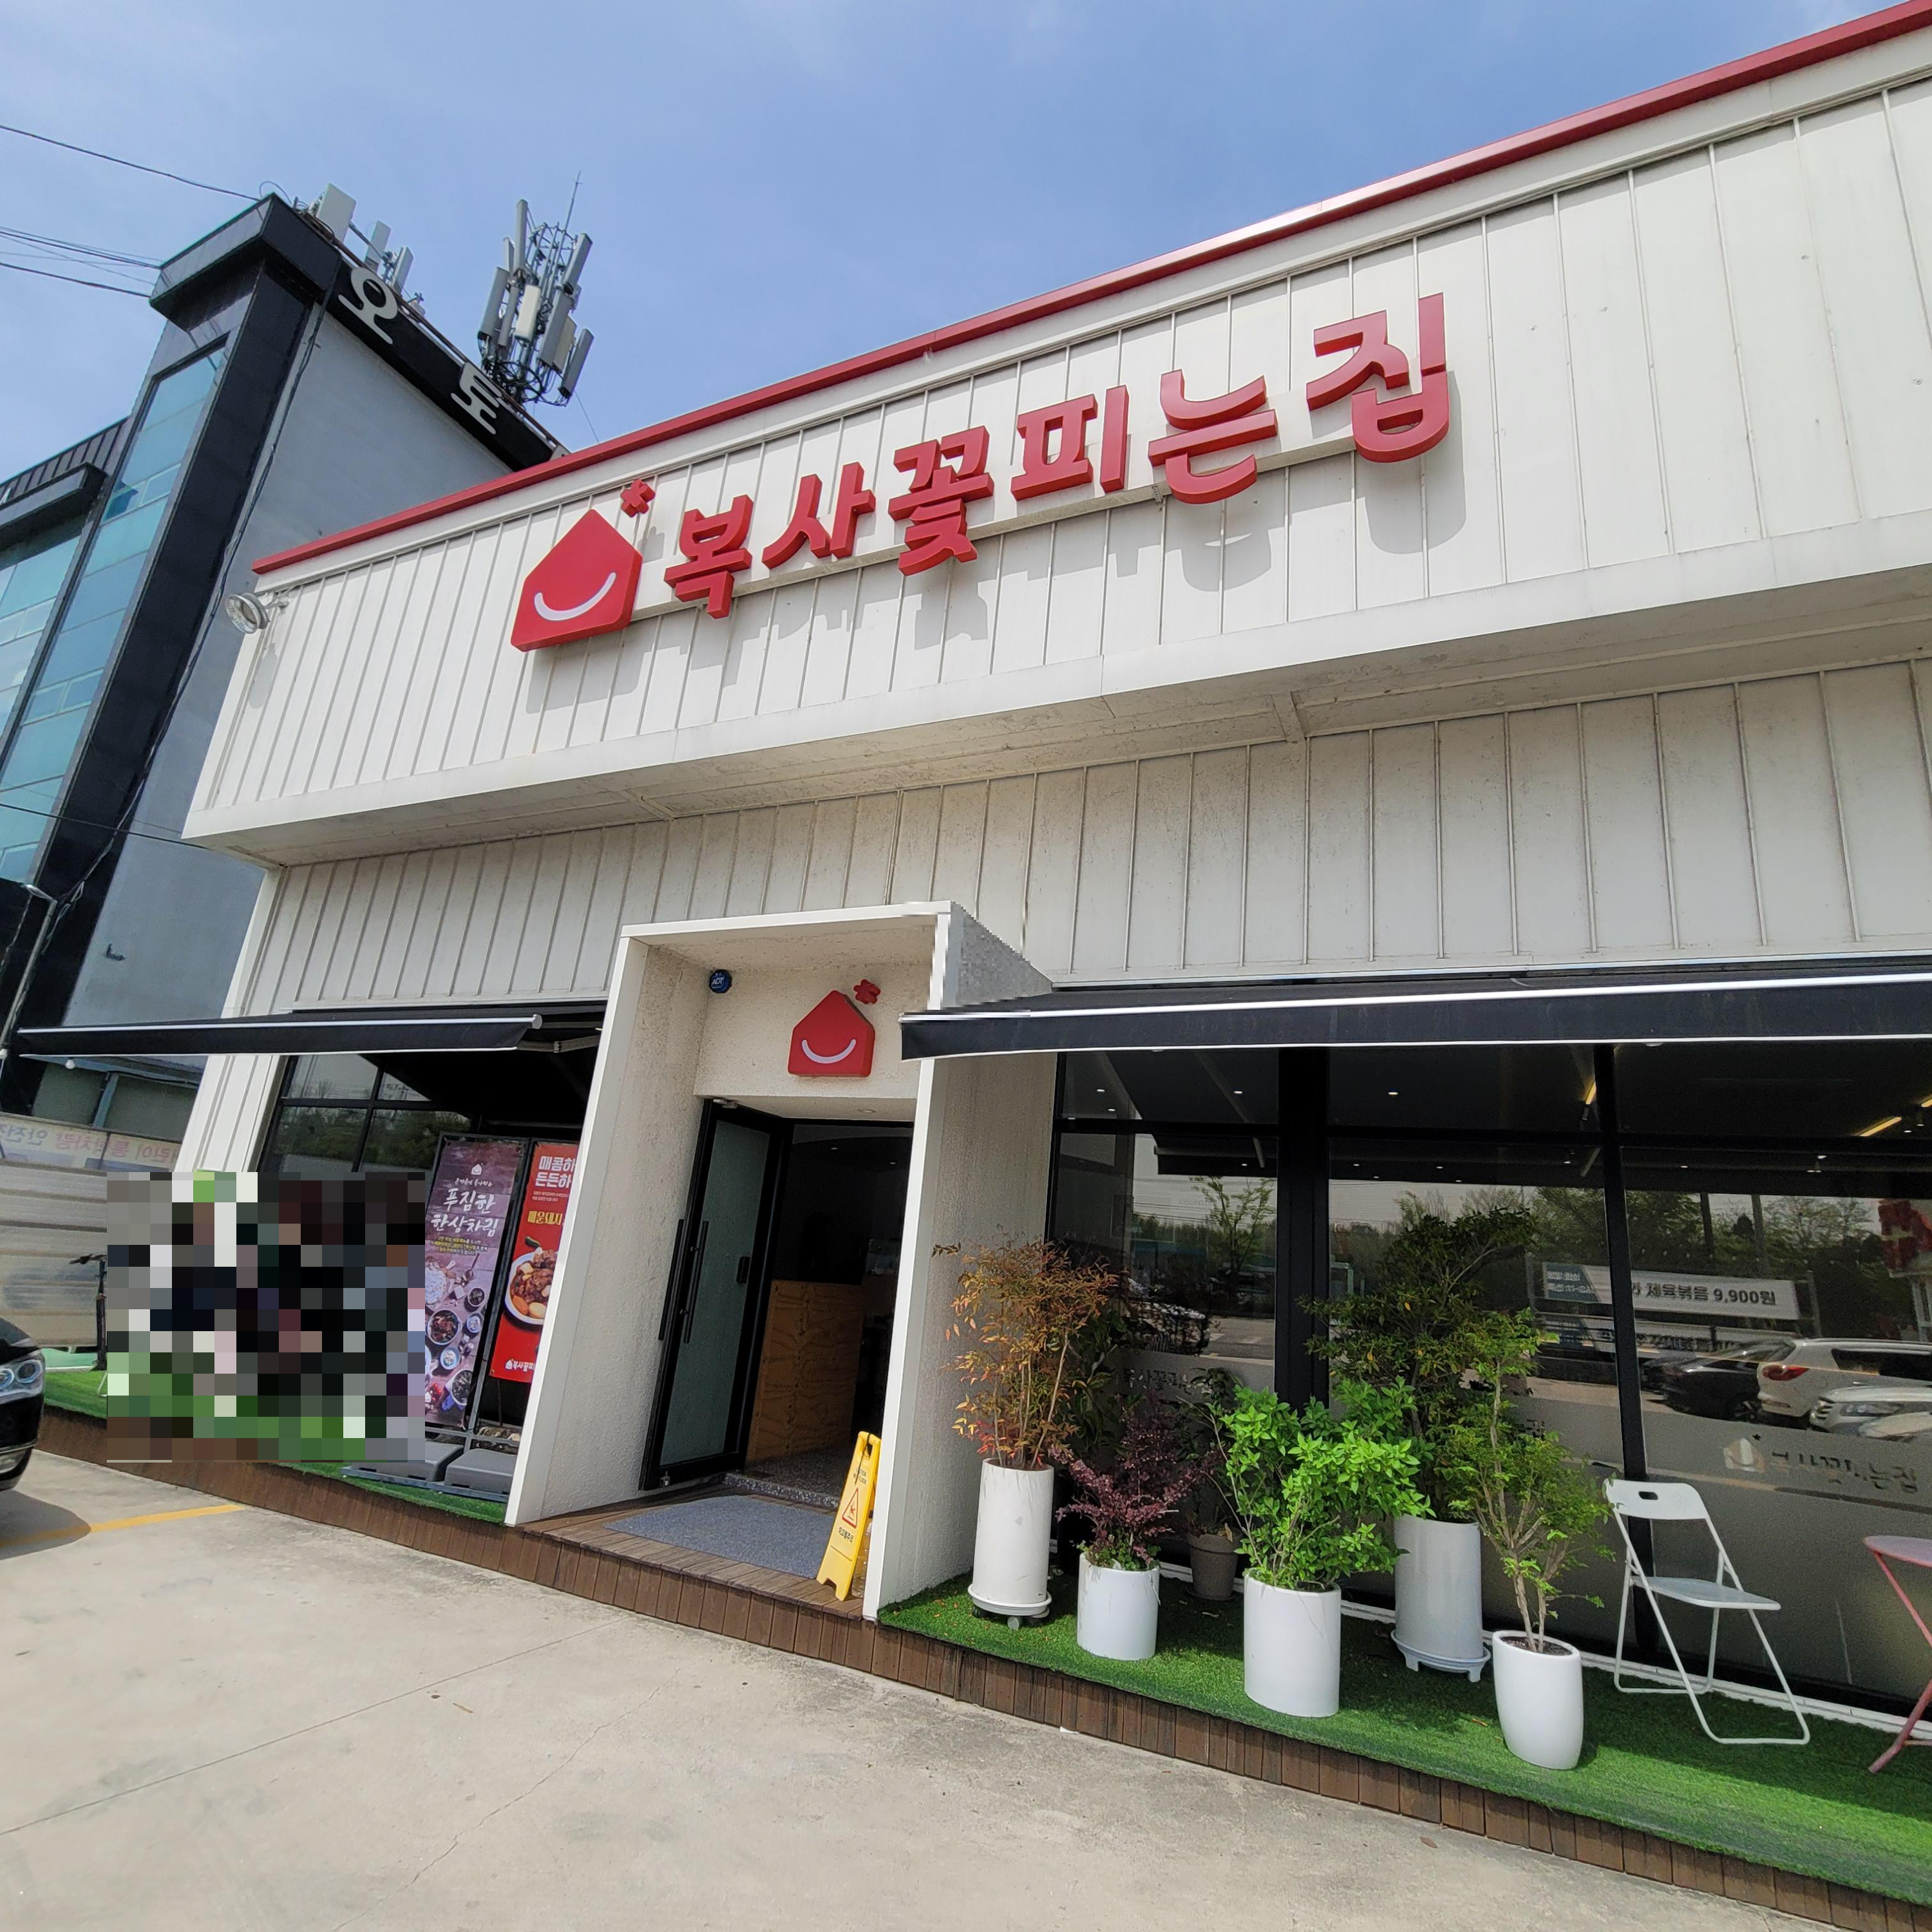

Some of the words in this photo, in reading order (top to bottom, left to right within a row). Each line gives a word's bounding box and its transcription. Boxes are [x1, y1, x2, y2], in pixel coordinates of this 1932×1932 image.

[339, 267, 571, 461] 오토
[664, 293, 1449, 618] 복사꽃피는집
[712, 977, 724, 985] ADT
[538, 1155, 576, 1172] 매콤하
[535, 1172, 571, 1188] 든든하
[443, 1188, 496, 1213] 푸짐한
[431, 1214, 498, 1236] 한상차림
[527, 1211, 563, 1226] 매운돼지
[1712, 1288, 1777, 1306] 9,900원
